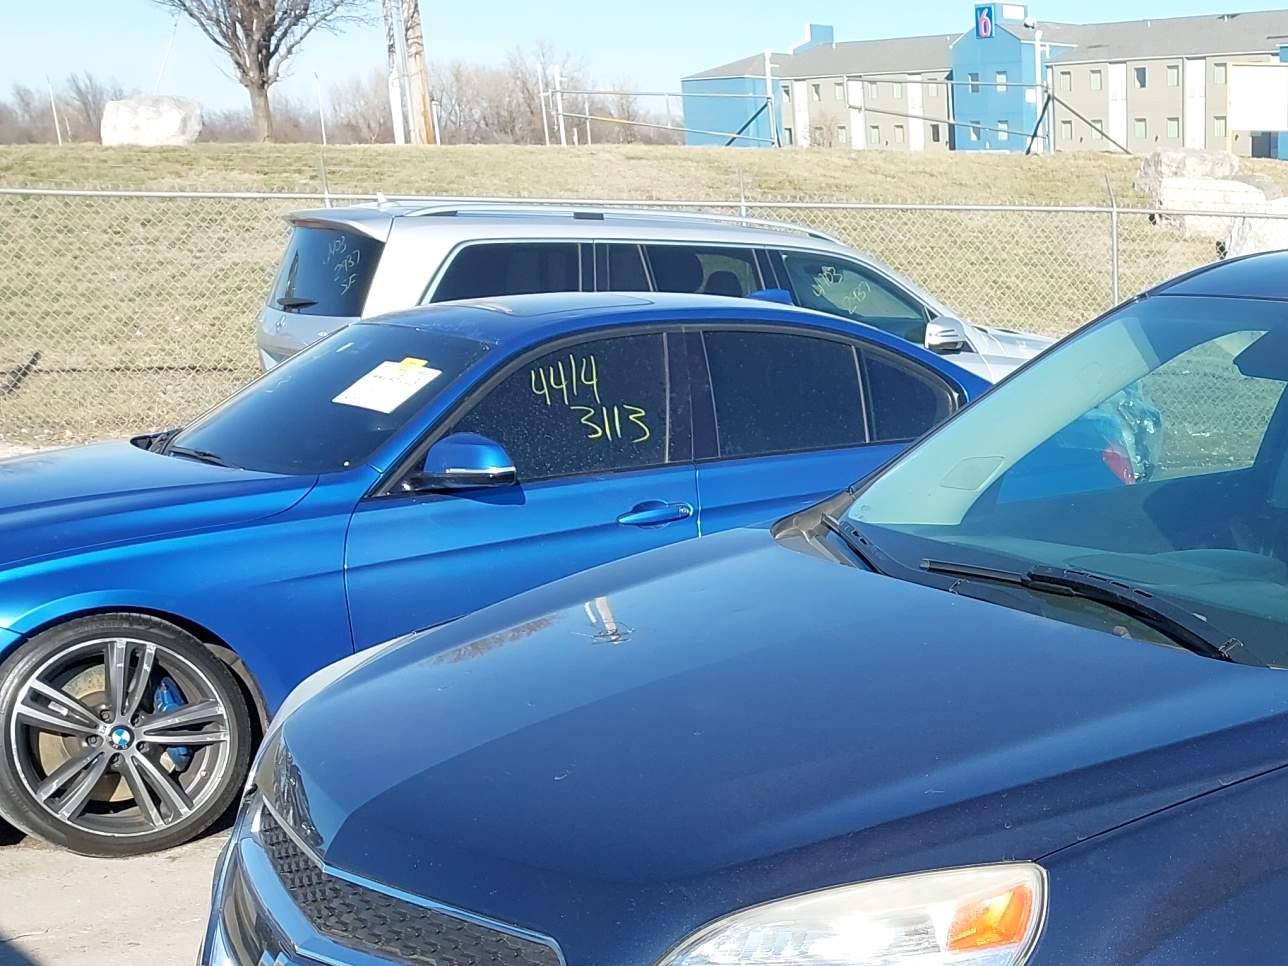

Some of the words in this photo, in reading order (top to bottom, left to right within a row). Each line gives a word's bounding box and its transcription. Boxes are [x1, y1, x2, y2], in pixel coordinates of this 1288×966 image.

[978, 7, 992, 38] 6
[529, 353, 601, 406] 4414
[570, 404, 650, 443] 3113
